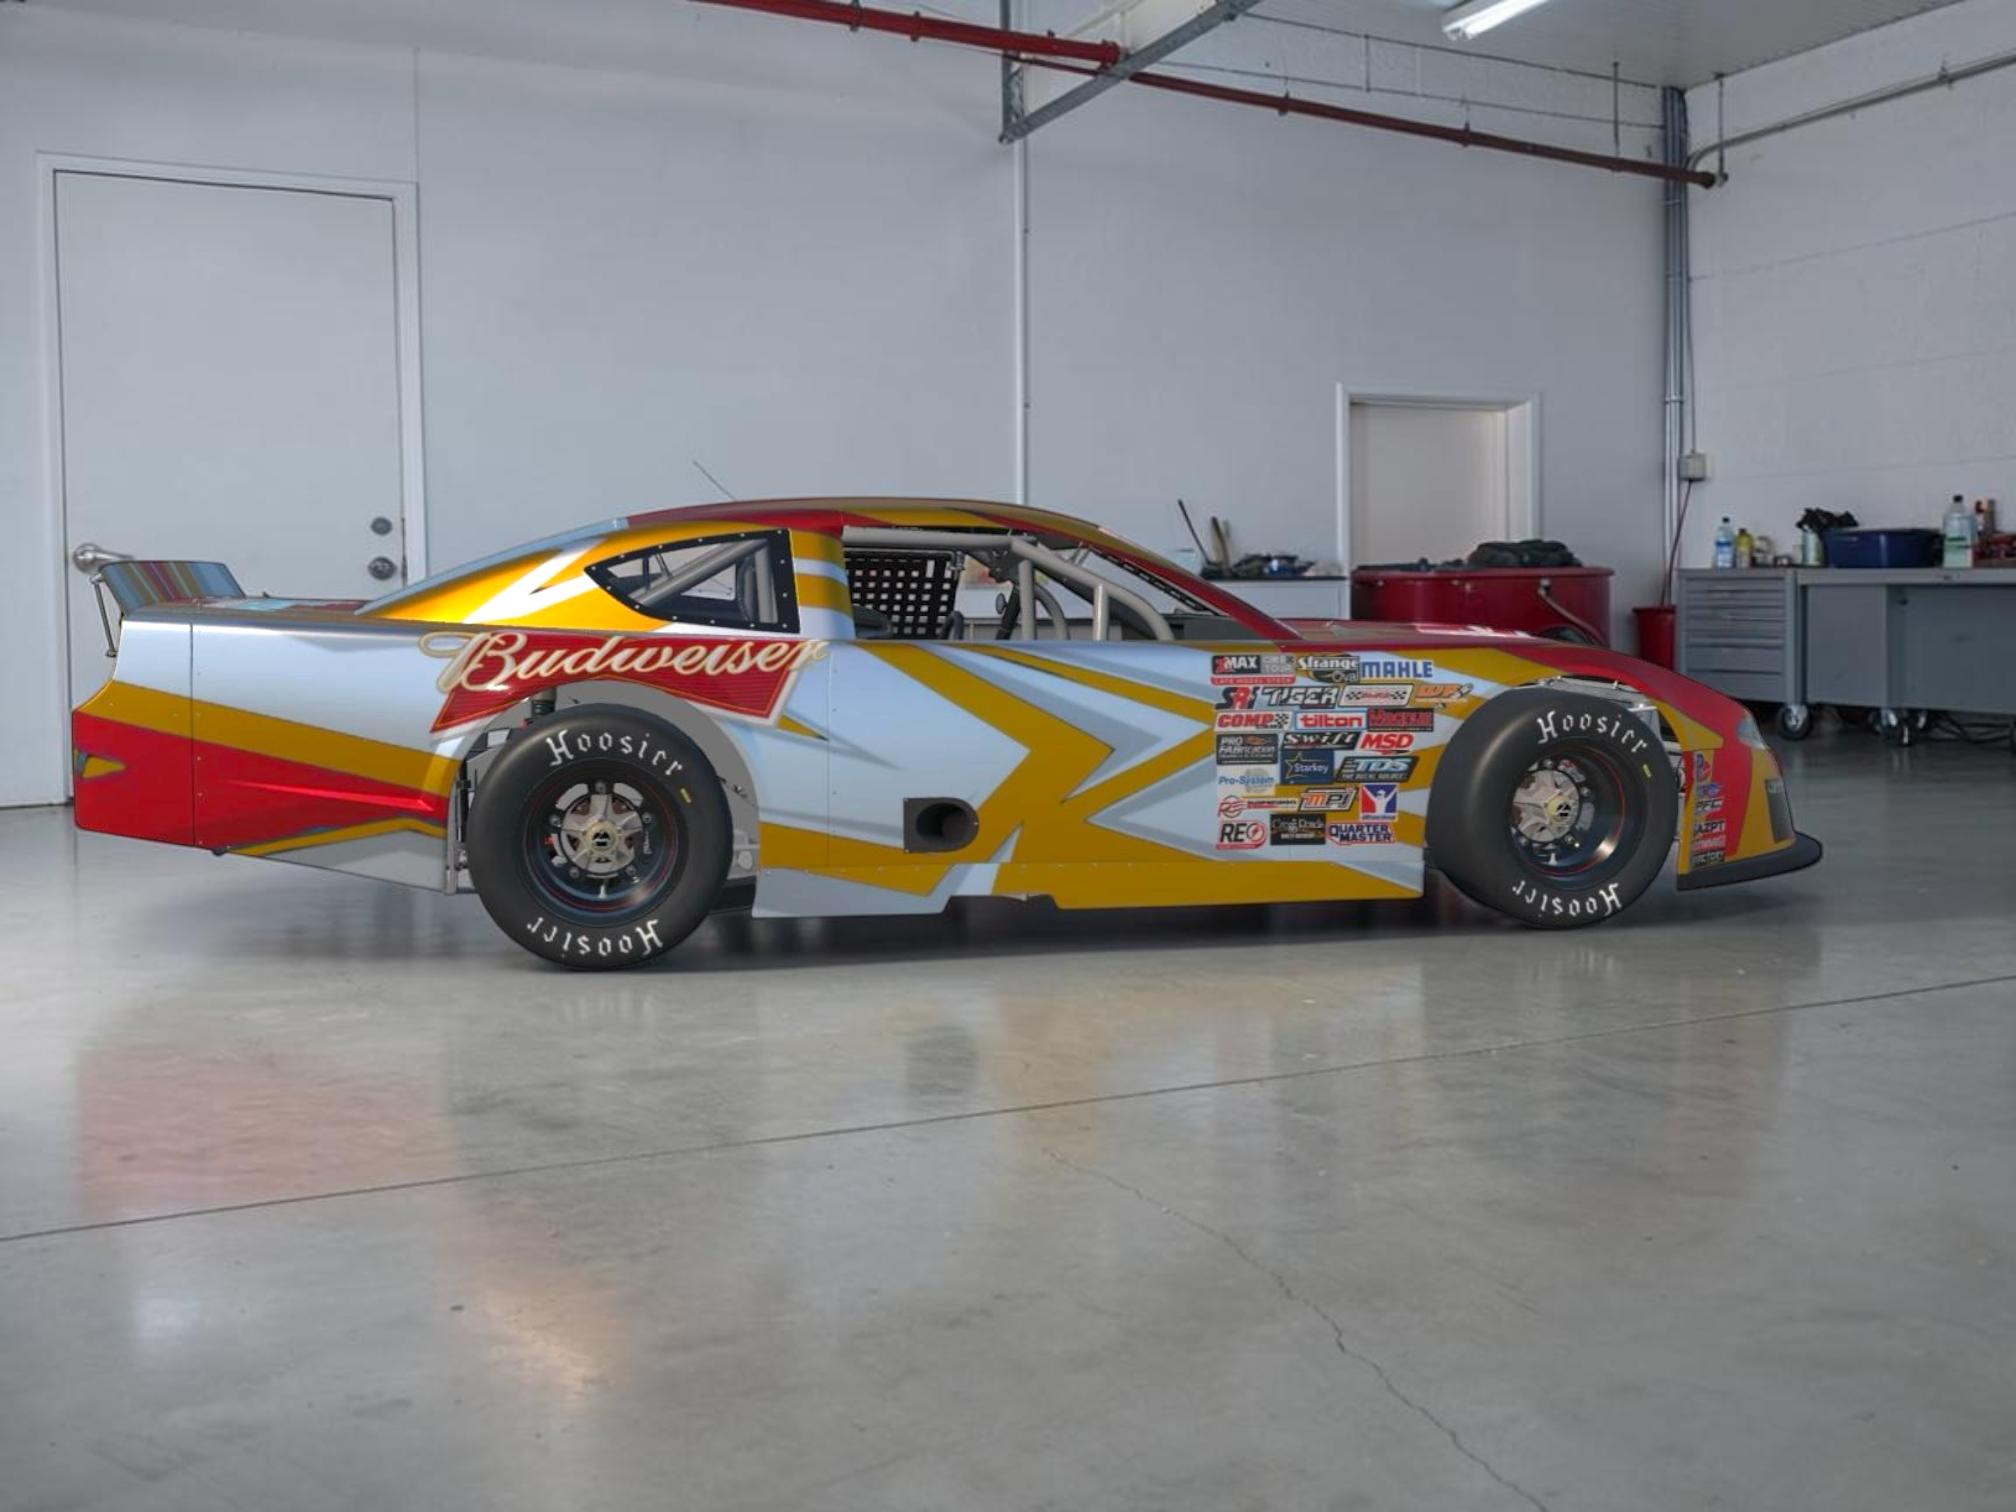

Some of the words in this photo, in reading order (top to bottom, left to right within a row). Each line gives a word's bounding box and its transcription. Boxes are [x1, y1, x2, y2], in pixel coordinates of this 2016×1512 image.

[417, 630, 829, 693] Budweiser
[1362, 661, 1432, 678] MAHLE
[1263, 687, 1338, 705] TIGER
[1217, 713, 1274, 728] COMP
[1299, 714, 1362, 728] tilton
[1536, 709, 1649, 755] Hoosier
[1360, 734, 1413, 749] MSD
[547, 729, 684, 777] Hoosier
[1294, 763, 1328, 774] Starkey
[1328, 824, 1389, 836] QUARTER
[1512, 879, 1622, 918] Hoosier
[527, 915, 664, 959] Hoosier
